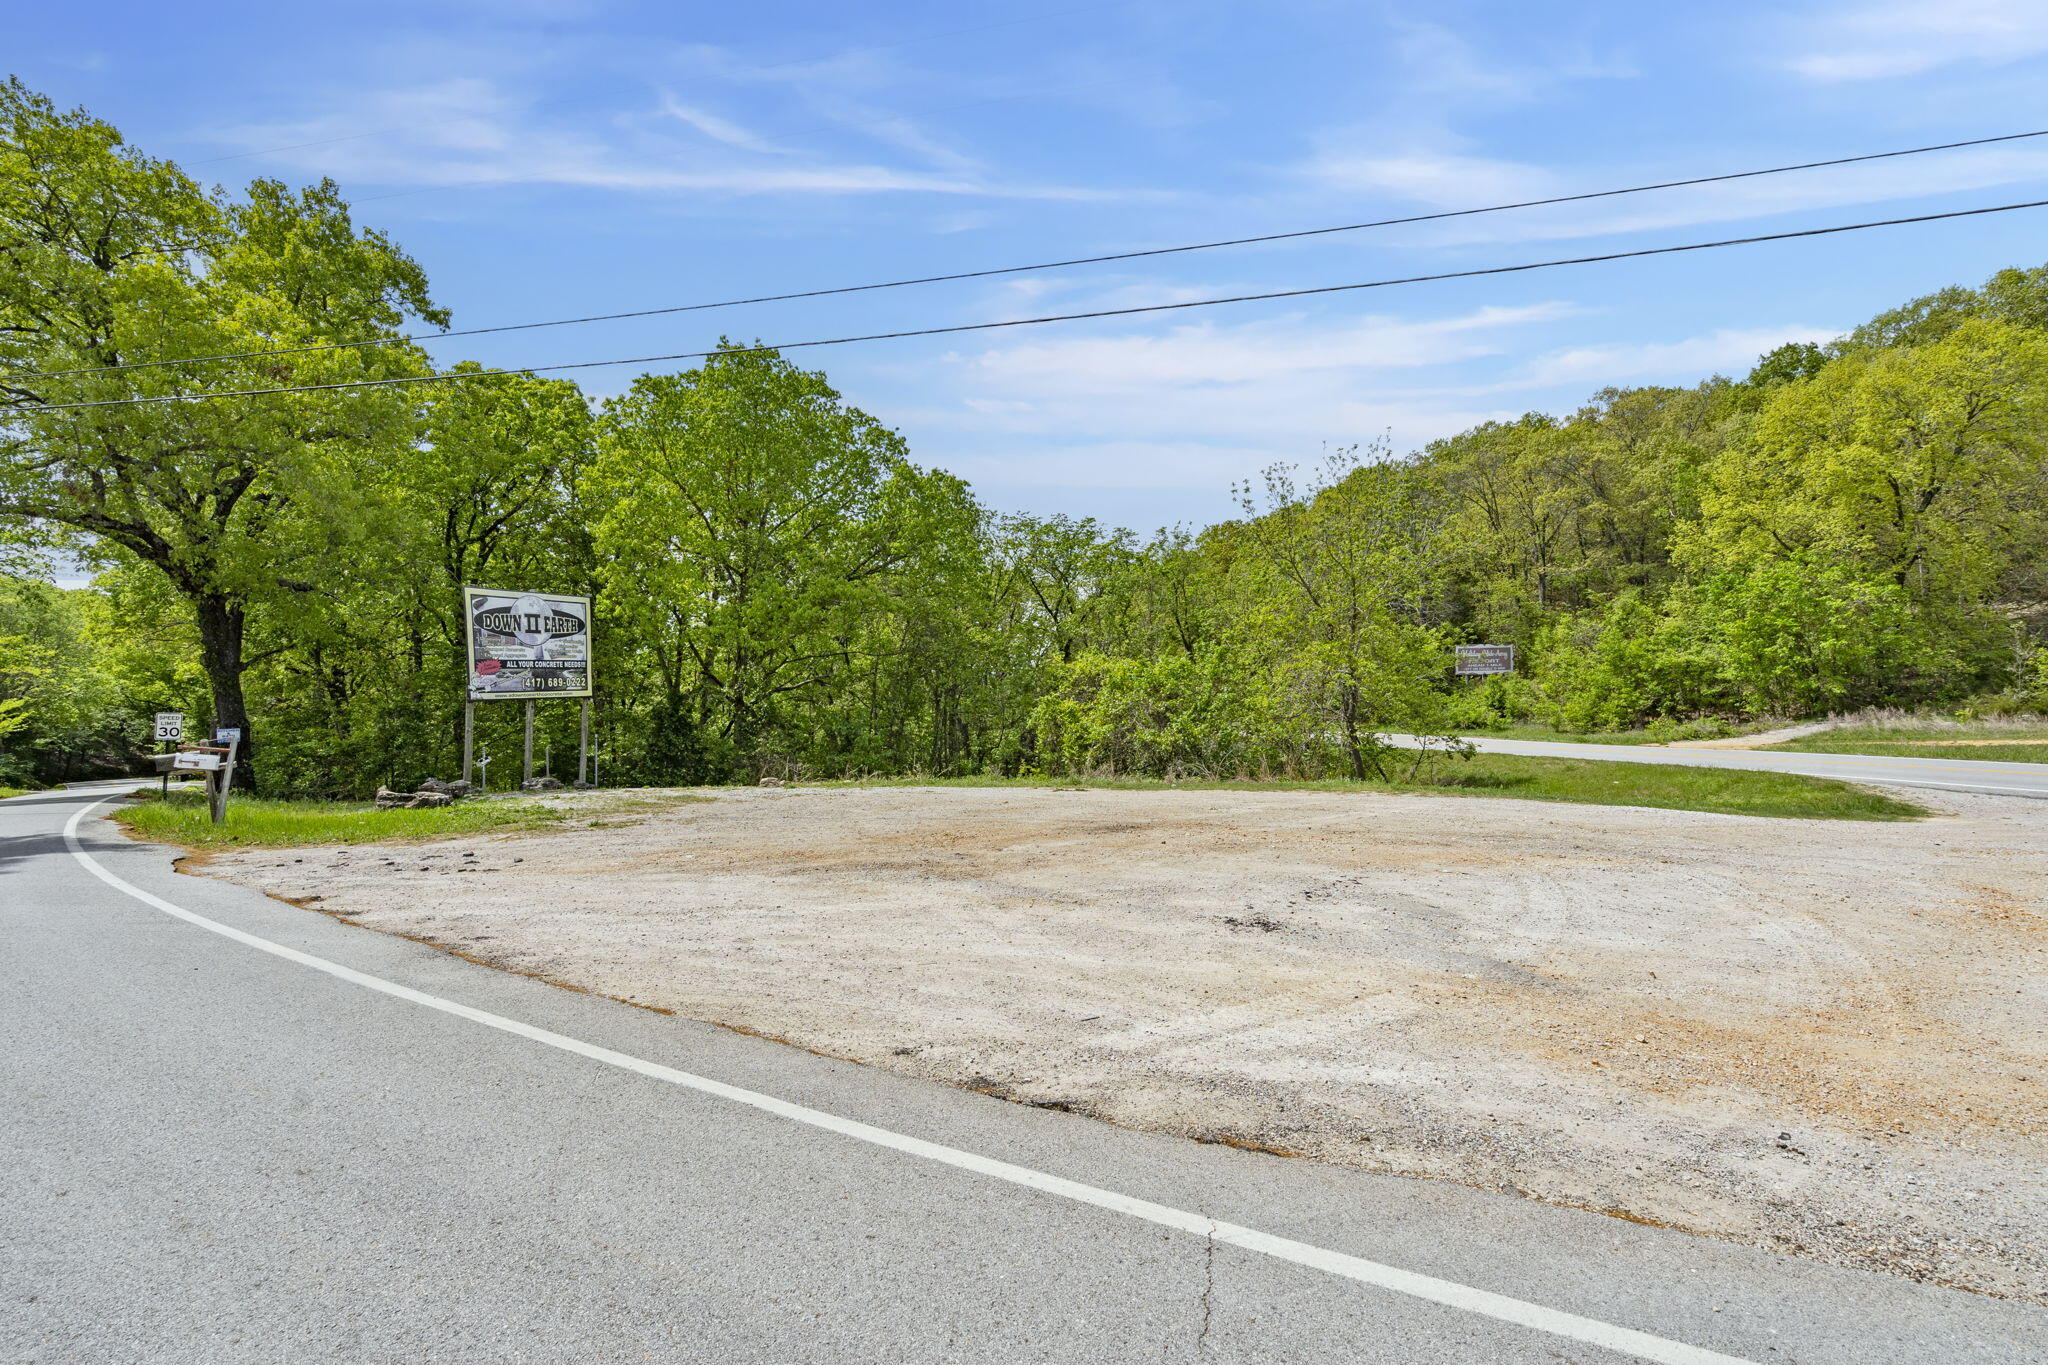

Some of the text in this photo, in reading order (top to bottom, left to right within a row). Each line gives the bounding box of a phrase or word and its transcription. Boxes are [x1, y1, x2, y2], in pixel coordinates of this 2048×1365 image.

[483, 613, 521, 632] DOWN
[543, 616, 579, 632] EARTH
[522, 677, 586, 689] (417) 689-0222
[158, 727, 180, 737] 30
